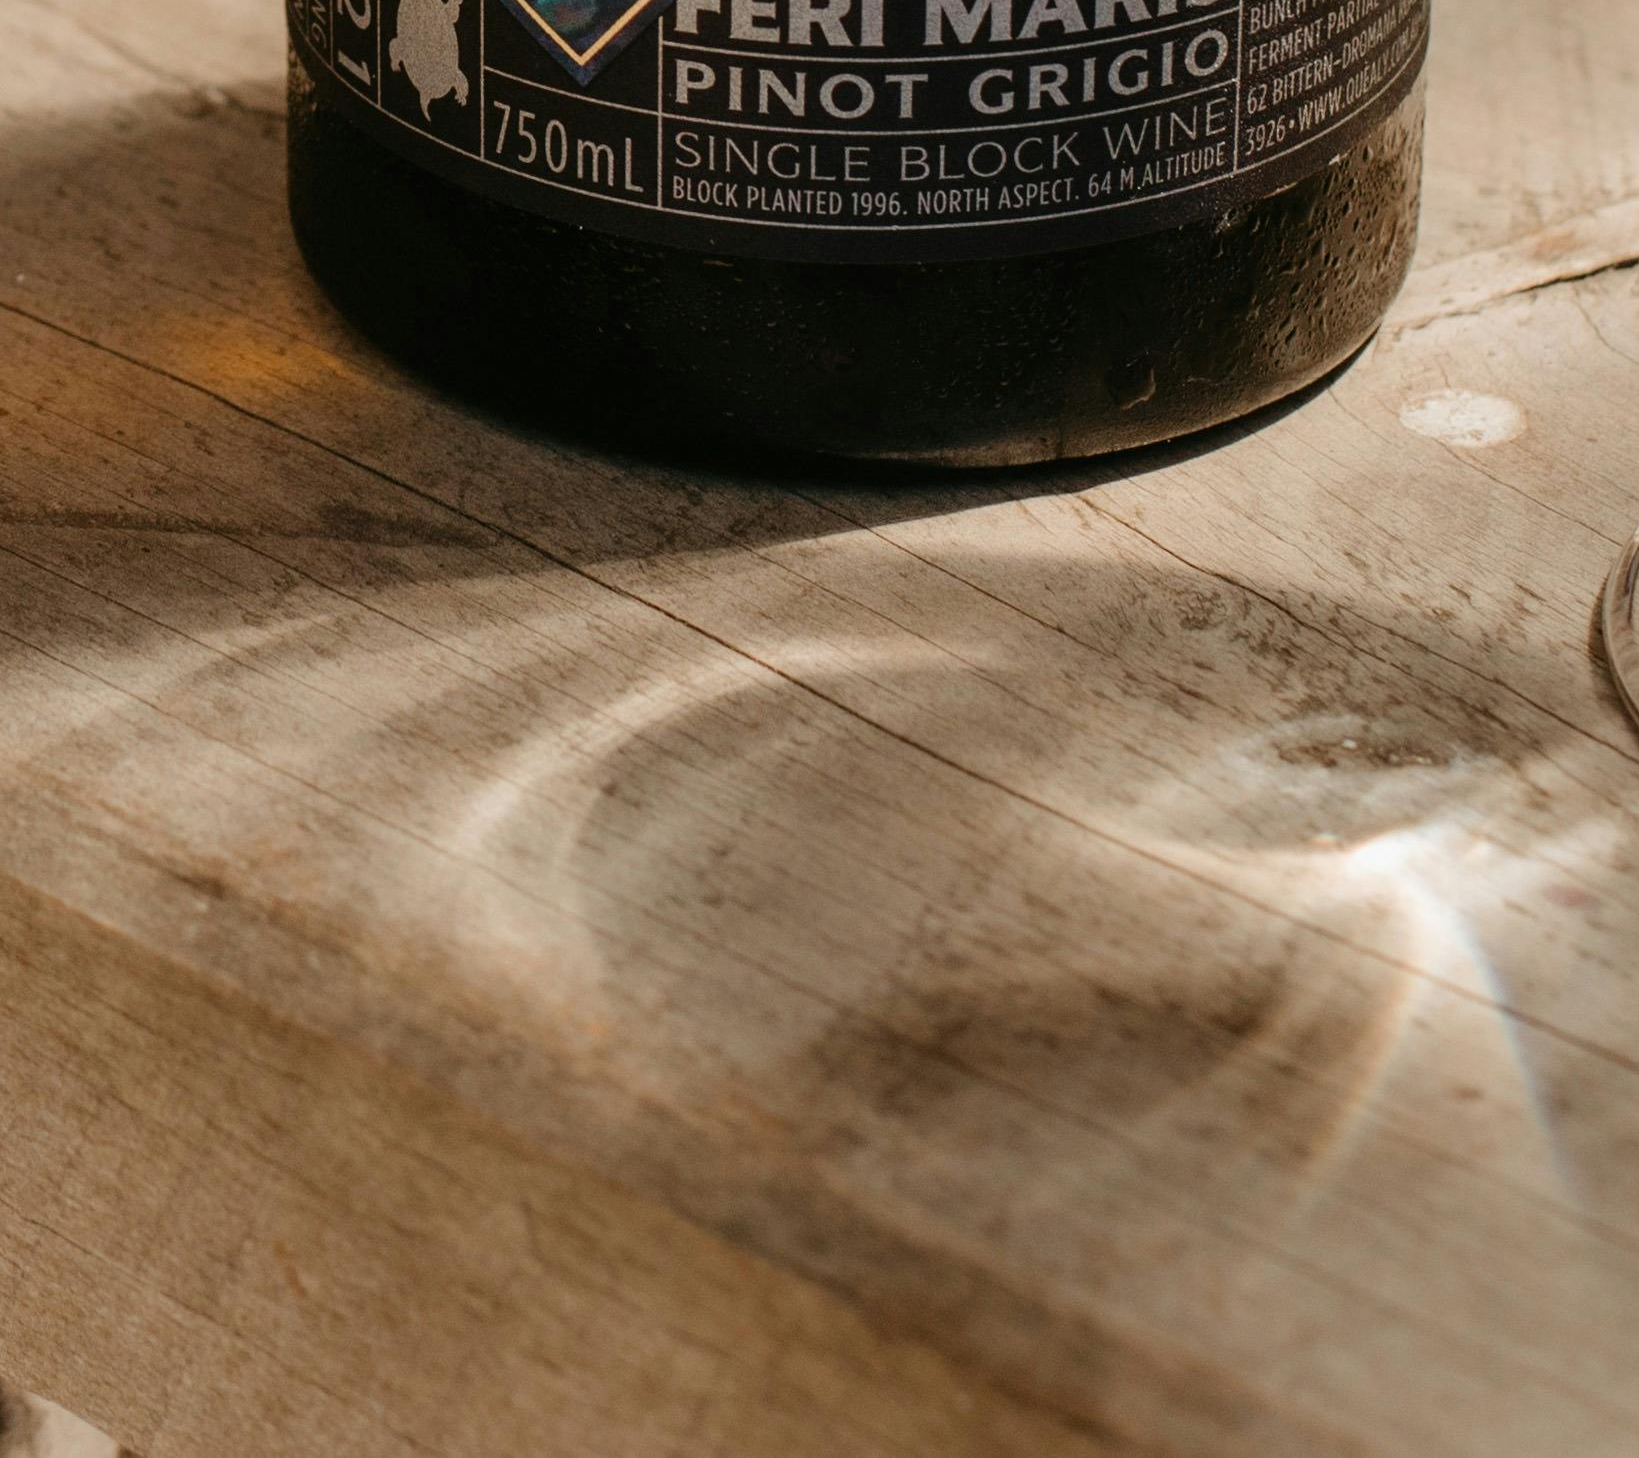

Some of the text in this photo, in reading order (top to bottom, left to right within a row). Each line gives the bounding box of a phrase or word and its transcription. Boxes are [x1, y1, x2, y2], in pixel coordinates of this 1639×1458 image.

[674, 28, 1230, 120] PINOT GRIGIO
[1248, 17, 1323, 76] FERMENT
[1244, 114, 1286, 157] 3926
[1247, 83, 1267, 115] 62
[494, 100, 644, 193] 750mL
[674, 95, 1228, 183] SINGLE BLOCK WINE
[672, 174, 736, 209] BLOCK
[746, 184, 842, 216] PLANTED
[851, 190, 908, 217] 1996.
[917, 186, 989, 216] NORTH
[998, 176, 1080, 211] ASPECT.
[1088, 172, 1112, 198] 64
[1141, 140, 1227, 188] ALTITUDE
